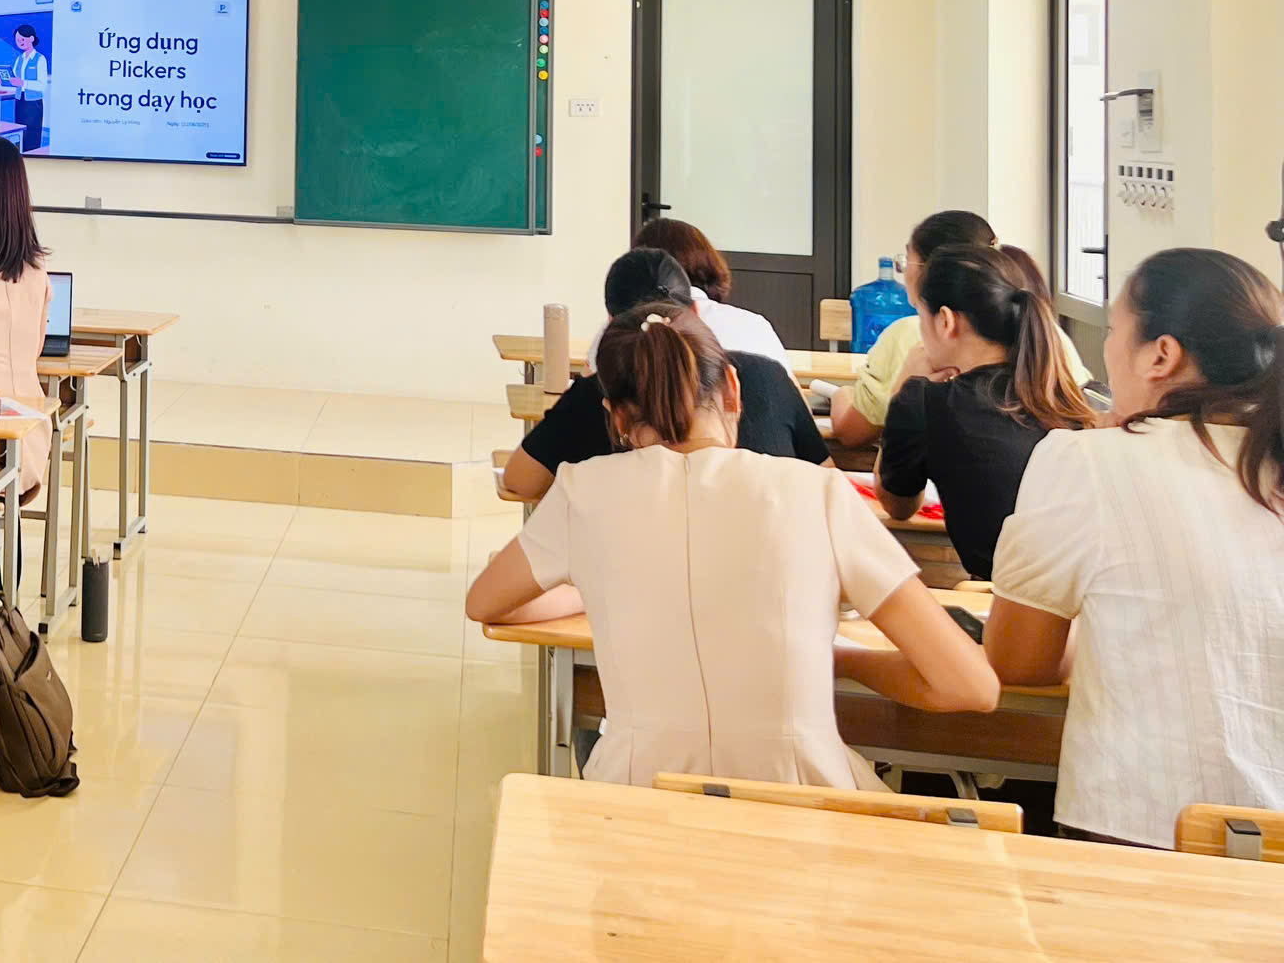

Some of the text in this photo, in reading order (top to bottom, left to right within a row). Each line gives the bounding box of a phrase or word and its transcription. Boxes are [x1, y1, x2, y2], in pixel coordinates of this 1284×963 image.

[98, 27, 199, 55] Ứng dụng
[109, 60, 186, 79] Plickers
[77, 88, 217, 113] trong dạy học
